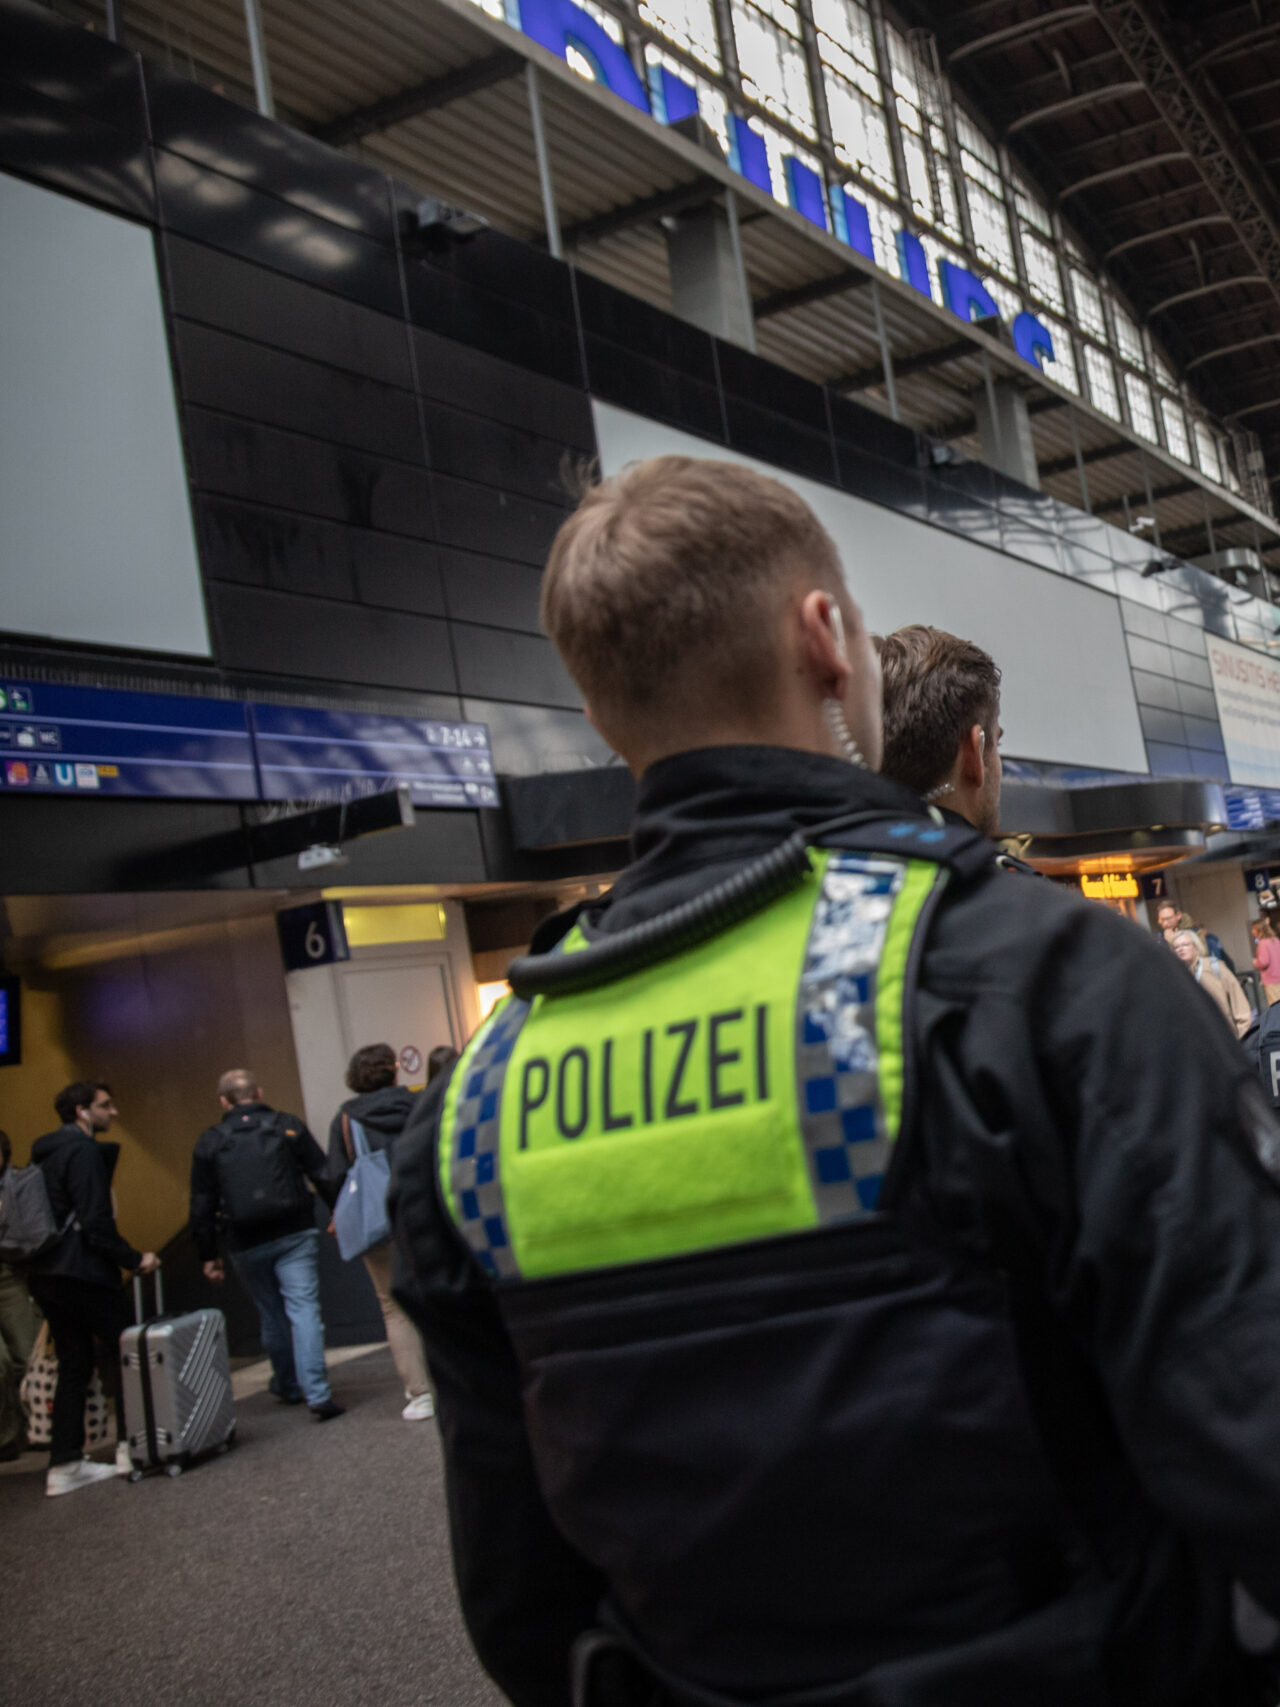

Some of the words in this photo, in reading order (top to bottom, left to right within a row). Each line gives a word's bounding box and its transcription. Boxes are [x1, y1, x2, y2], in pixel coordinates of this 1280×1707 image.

[1151, 878, 1163, 896] 7
[1255, 874, 1266, 889] 8
[304, 922, 325, 959] 6
[519, 1003, 768, 1151] POLIZEI
